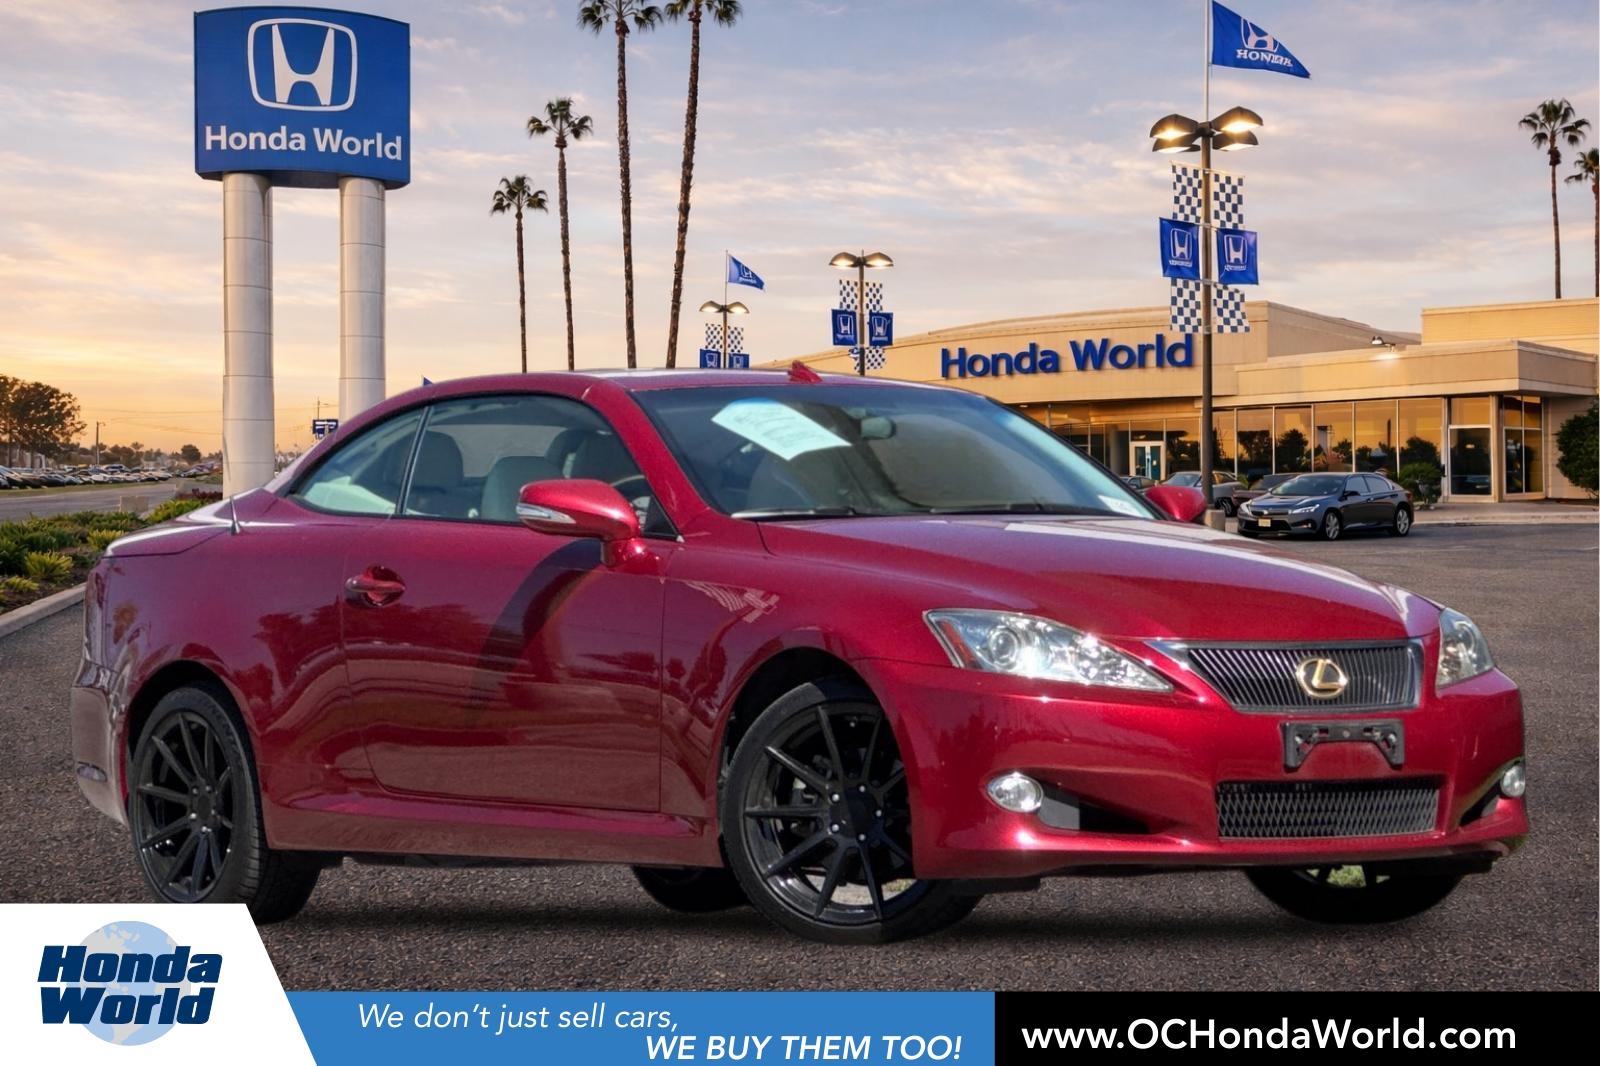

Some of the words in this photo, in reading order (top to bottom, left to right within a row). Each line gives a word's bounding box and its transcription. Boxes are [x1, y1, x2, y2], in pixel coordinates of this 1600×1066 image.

[205, 125, 306, 151] Honda
[313, 127, 402, 160] World
[941, 343, 1060, 378] Honda
[1070, 333, 1194, 370] World
